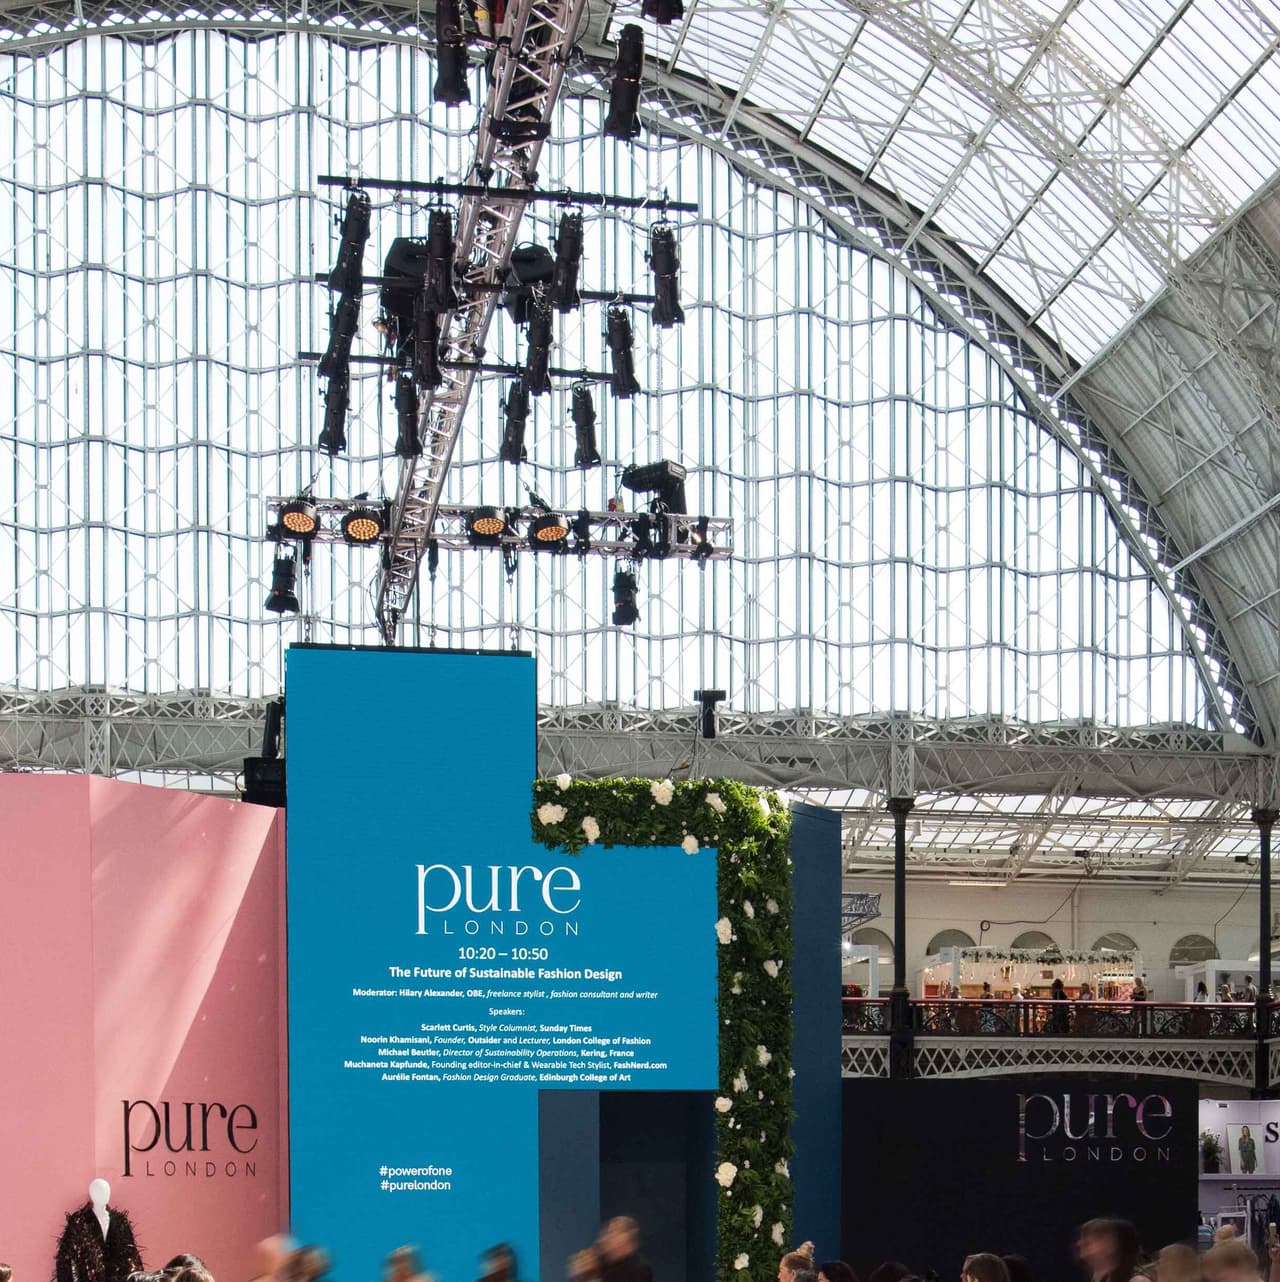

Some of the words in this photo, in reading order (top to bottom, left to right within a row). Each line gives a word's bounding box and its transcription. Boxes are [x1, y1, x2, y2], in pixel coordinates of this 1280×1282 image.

[415, 864, 581, 935] pure
[444, 919, 579, 936] LONDON
[459, 947, 496, 959] 10:20
[512, 948, 548, 960] 10:50
[389, 966, 411, 977] The
[414, 967, 452, 977] Future
[455, 967, 467, 978] of
[469, 968, 535, 978] Sustainable
[538, 968, 581, 979] Fashion
[584, 969, 622, 981] Design
[353, 988, 398, 997] Moderator:
[399, 989, 422, 998] Hilary
[424, 989, 464, 998] Alexander,
[467, 989, 485, 998] OBE,
[486, 989, 521, 998] freelance
[550, 990, 578, 999] fashion
[580, 990, 618, 998] consultant
[620, 990, 634, 998] and
[489, 1007, 524, 1016] Speakers:
[421, 1023, 451, 1031] Scarlett
[452, 1023, 477, 1032] Curtis,
[479, 1023, 497, 1032] Style
[499, 1023, 537, 1032] Columnist,
[540, 1024, 568, 1033] Sunday
[569, 1024, 592, 1032] Times
[361, 1035, 388, 1043] Noorin
[434, 1035, 465, 1044] Founder,
[503, 1036, 517, 1044] and
[519, 1036, 550, 1044] Lecturer,
[553, 1036, 581, 1044] London
[583, 1037, 610, 1046] College
[612, 1036, 620, 1044] of
[622, 1036, 651, 1044] Fashion
[378, 1047, 409, 1056] Michael
[443, 1048, 474, 1056] Director
[475, 1049, 484, 1058] of
[484, 1048, 535, 1057] Sustainability
[536, 1049, 579, 1058] Operations,
[581, 1049, 607, 1058] Kering,
[609, 1049, 634, 1057] France
[344, 1059, 388, 1068] Muchaneta
[432, 1061, 467, 1070] Founding
[468, 1060, 521, 1068] editor-in-chief
[524, 1060, 529, 1068] &
[532, 1060, 567, 1068] Wearable
[569, 1060, 585, 1068] Tech
[588, 1061, 611, 1070] Stylist,
[412, 1072, 441, 1081] Fontan,
[474, 1073, 499, 1082] Design
[500, 1073, 537, 1081] Graduate,
[539, 1073, 578, 1082] Edinburgh
[580, 1073, 607, 1082] College
[609, 1073, 617, 1081] of
[619, 1073, 631, 1081] Art
[1016, 1093, 1173, 1162] pure
[120, 1099, 259, 1177] pure
[1043, 1147, 1170, 1162] LONDON
[146, 1161, 257, 1177] LONDON
[379, 1165, 452, 1178] #powerofone
[381, 1180, 451, 1192] #purelondon
